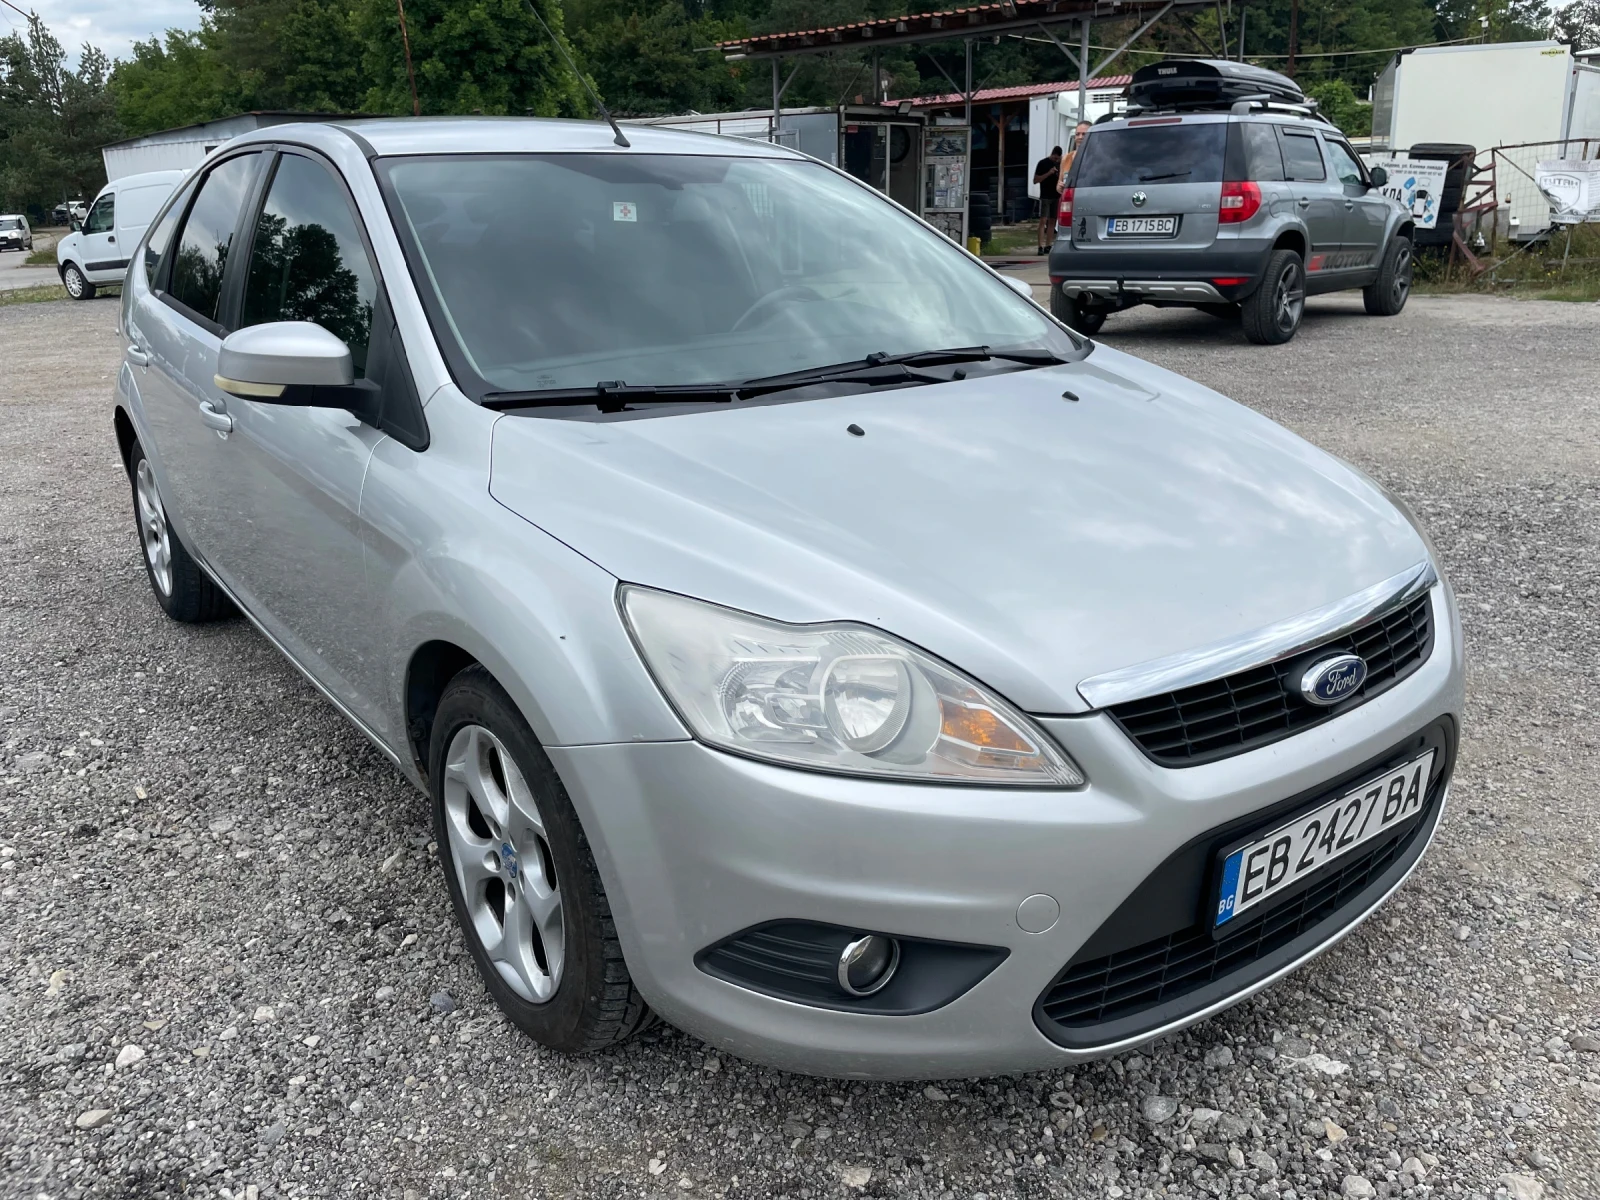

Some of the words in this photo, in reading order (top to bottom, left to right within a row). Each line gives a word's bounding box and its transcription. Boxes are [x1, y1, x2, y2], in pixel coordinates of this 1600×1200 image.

[1157, 67, 1178, 75] THULE
[1131, 220, 1155, 232] 1715
[1156, 220, 1172, 231] BC
[1326, 665, 1357, 695] Ford
[1240, 834, 1292, 905] EB
[1295, 785, 1383, 873] 2427
[1380, 764, 1423, 826] BA
[1218, 895, 1234, 915] BG
